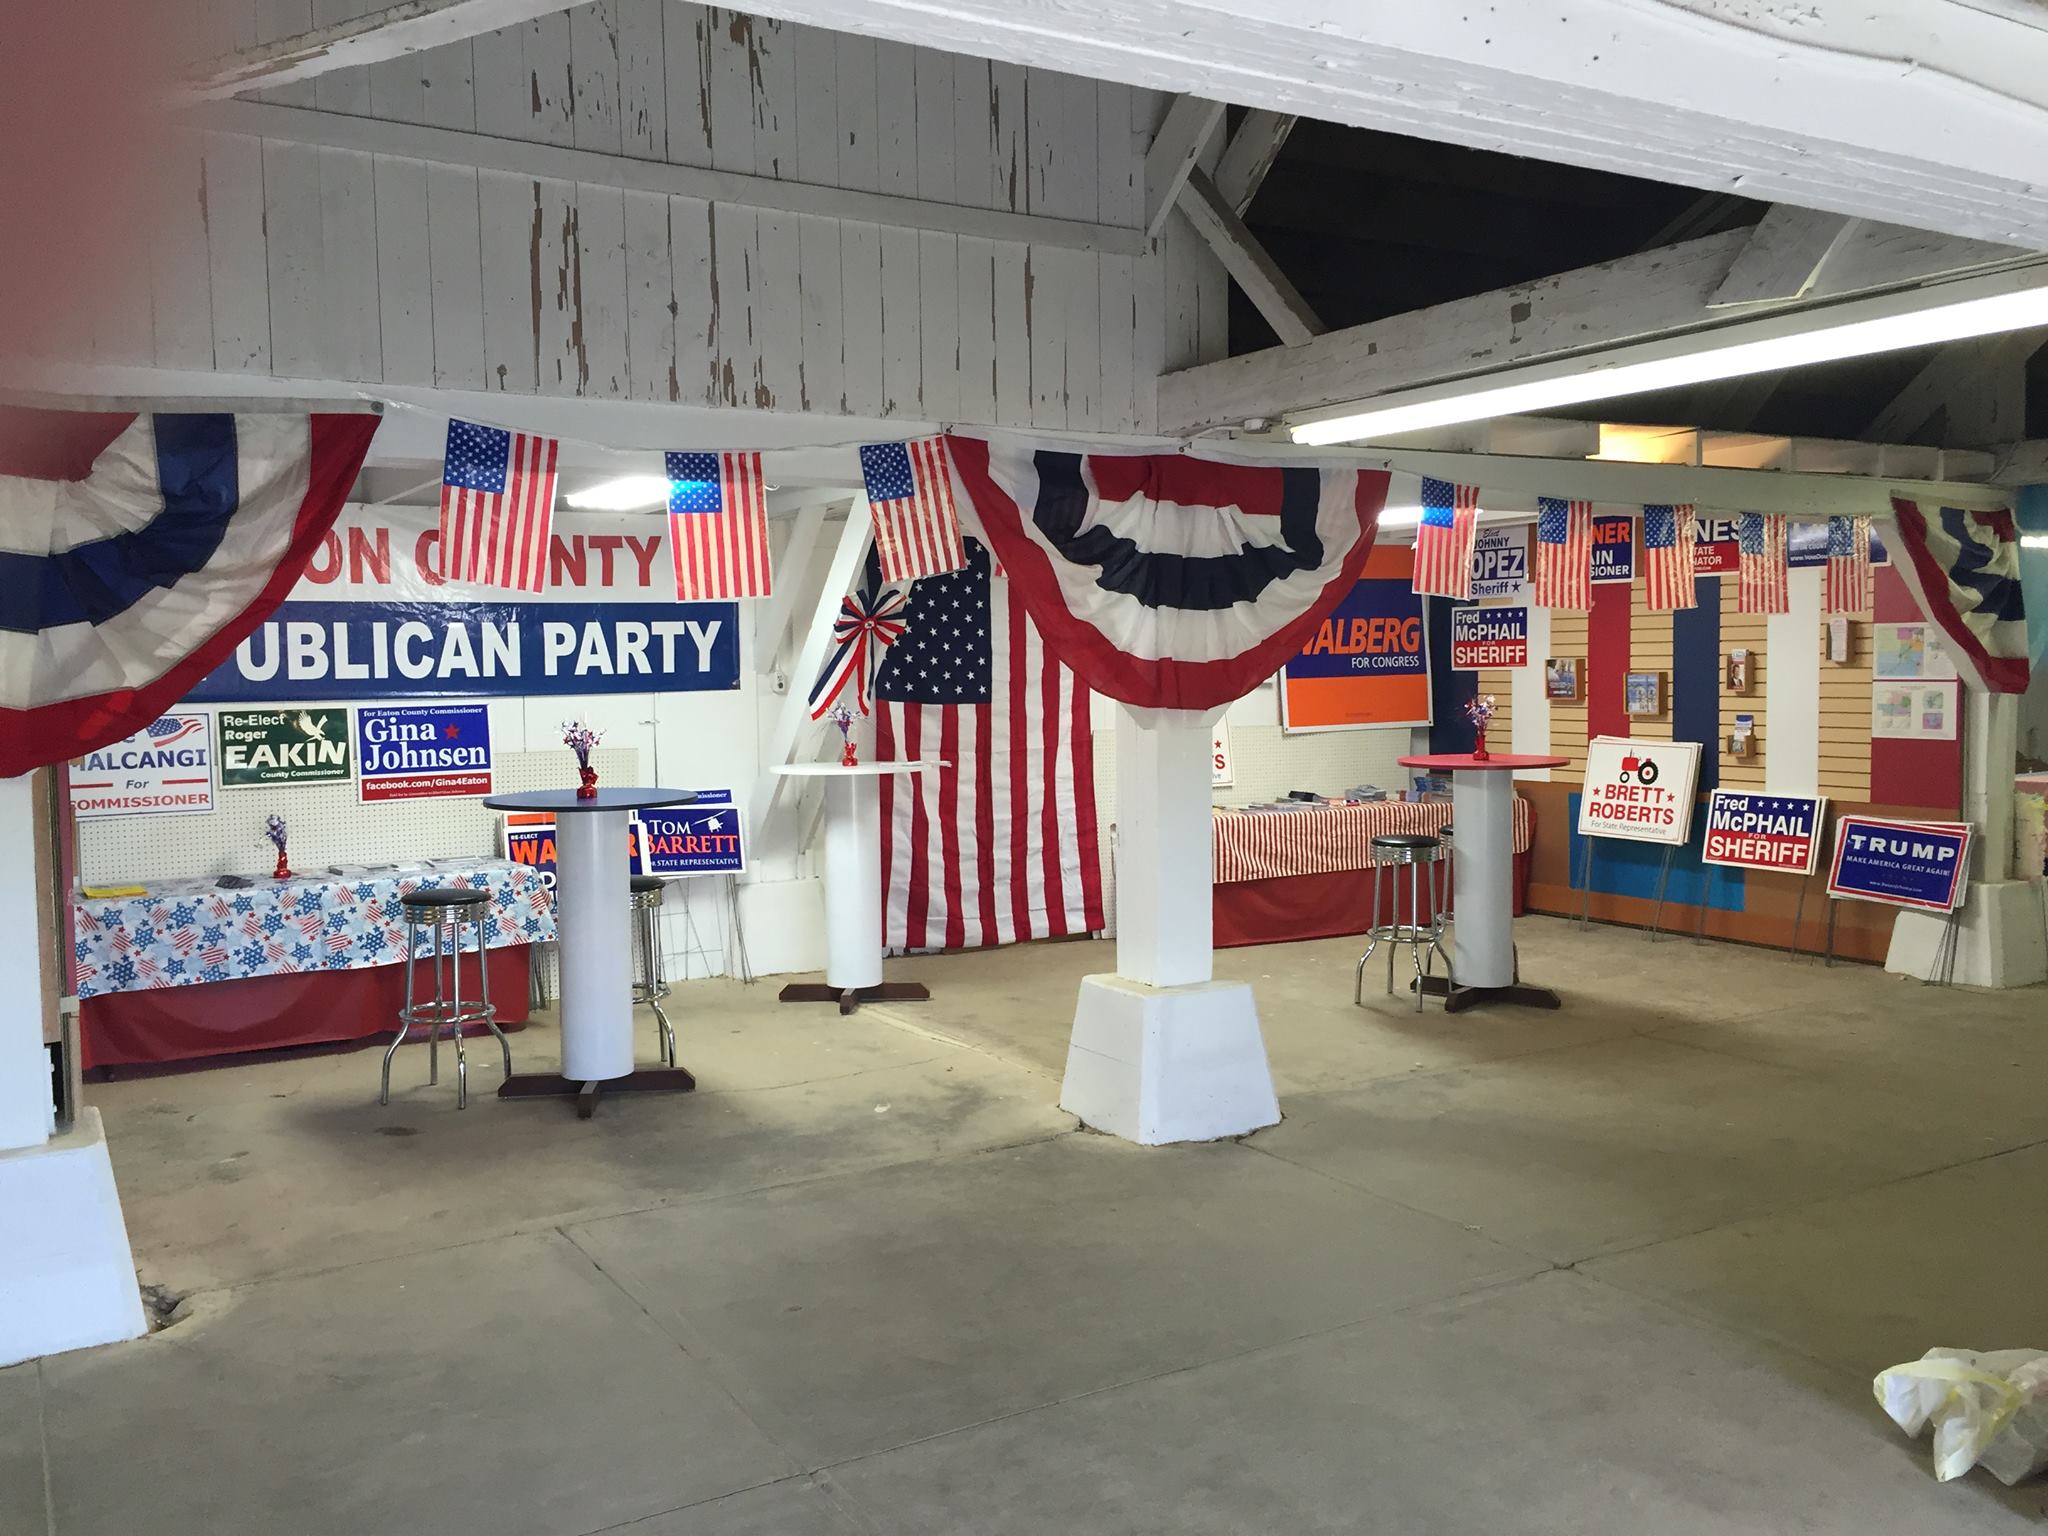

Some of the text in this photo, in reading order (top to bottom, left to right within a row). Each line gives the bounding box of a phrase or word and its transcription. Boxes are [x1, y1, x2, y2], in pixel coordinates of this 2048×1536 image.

[1474, 536, 1510, 549] JOHNNY
[415, 530, 662, 587] CNTY
[1471, 581, 1509, 595] Sheriff
[1456, 611, 1480, 624] Fred
[1455, 623, 1526, 642] McPHAIL
[543, 620, 722, 676] PARTY
[1455, 645, 1526, 664] SHERIFF
[1351, 655, 1420, 669] FOR CONGRESS
[223, 712, 286, 727] Re-Elect
[377, 709, 400, 717] Eaton
[401, 708, 428, 717] County
[430, 706, 483, 715] Commissioner
[225, 730, 268, 743] Roger
[365, 717, 438, 743] Gina
[226, 740, 346, 770] EAKIN
[365, 741, 487, 771] Johnsen
[260, 768, 344, 779] County Commissioner
[126, 780, 149, 789] For
[366, 776, 488, 791] facebook.com/Gina4Eaton
[1604, 783, 1665, 804] BRETT
[1714, 795, 1749, 812] Fred
[1588, 801, 1675, 826] ROBERTS
[649, 819, 692, 836] TOM
[1602, 821, 1619, 830] State
[1619, 823, 1667, 836] Representative
[1712, 810, 1810, 838] McPHAIL
[510, 833, 539, 841] RE-ELECT
[647, 833, 738, 855] BARRETT
[1748, 832, 1767, 840] FOR
[1709, 835, 1808, 865] SHERIFF
[1850, 834, 1955, 862] TRUMP
[656, 859, 678, 867] STATE
[680, 857, 740, 867] REPRESENTATIVE
[1846, 855, 1951, 877] MAKE AMERICA GREAT AGAIN!
